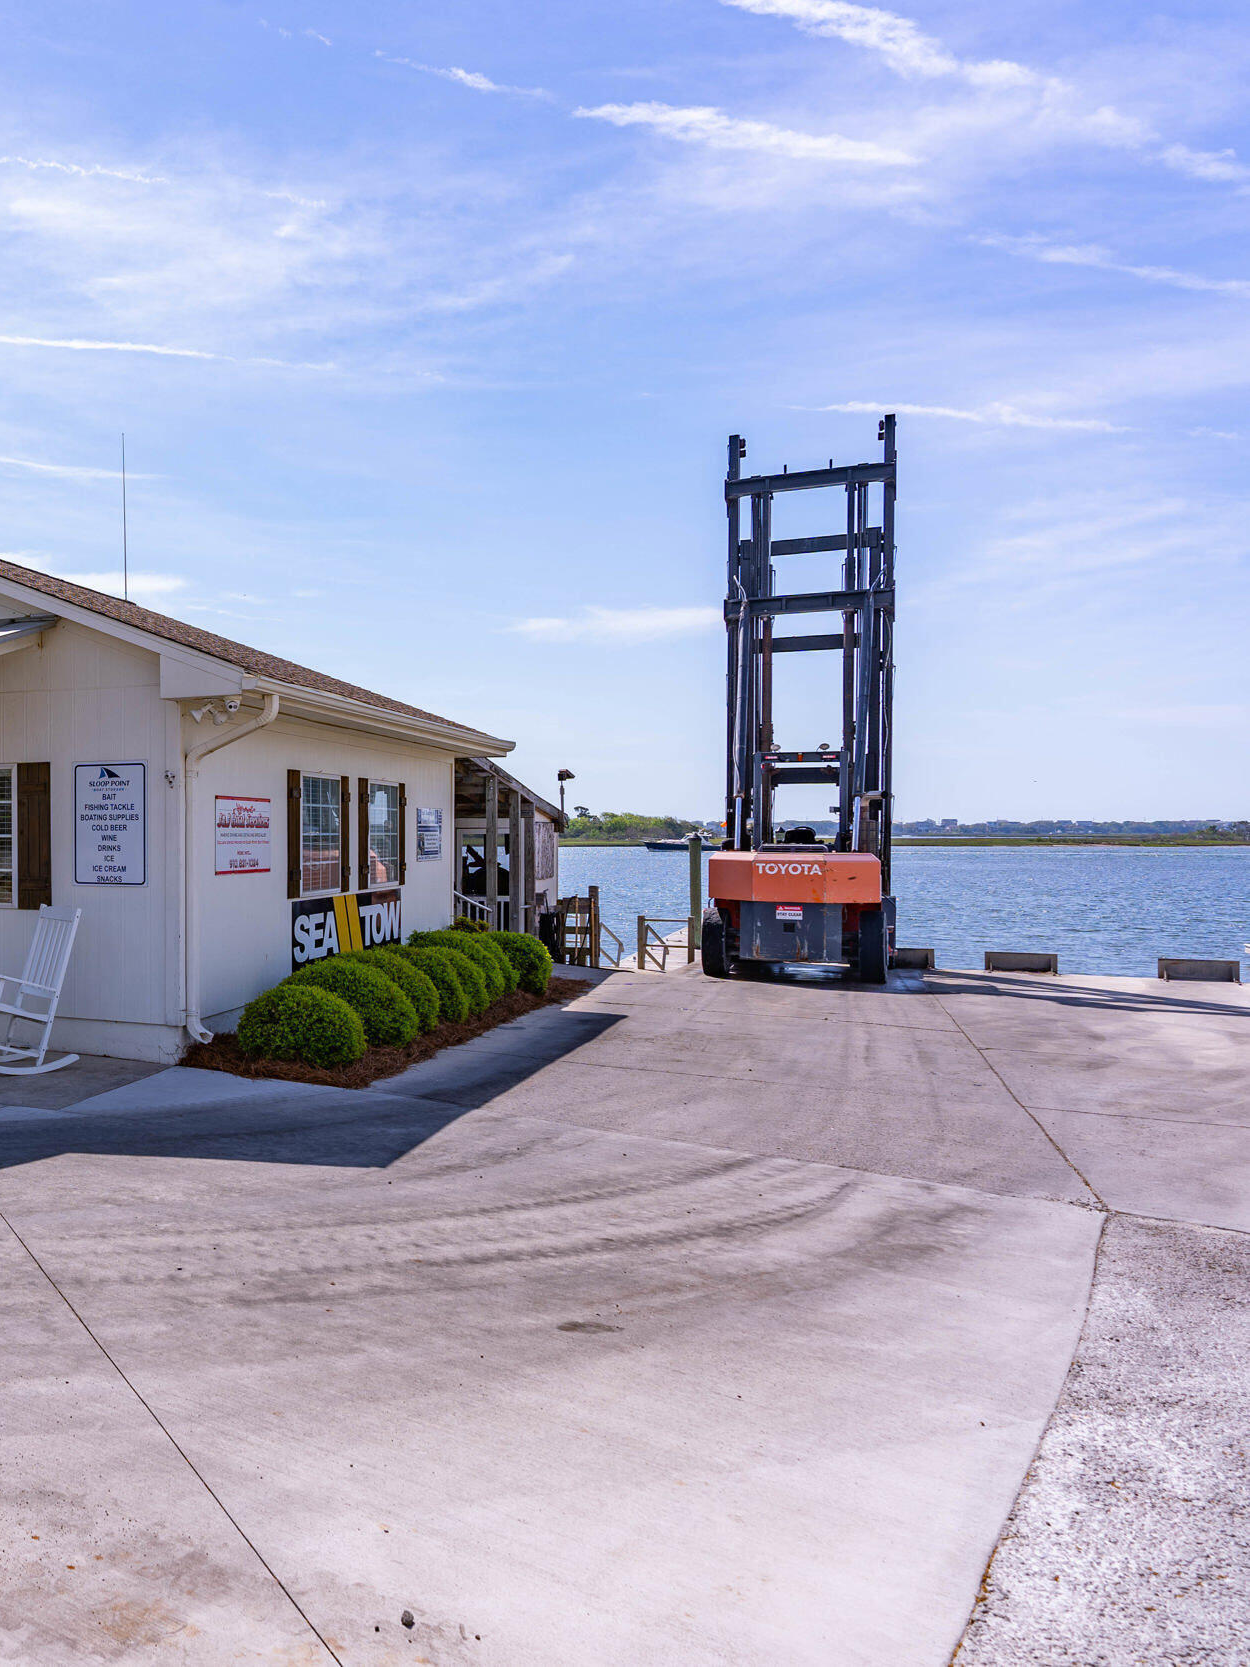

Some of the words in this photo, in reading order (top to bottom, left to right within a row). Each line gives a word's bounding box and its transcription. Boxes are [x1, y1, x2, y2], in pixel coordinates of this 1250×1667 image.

[756, 863, 822, 875] TOYOTA
[294, 911, 339, 963] SEA
[359, 900, 400, 946] TOW
